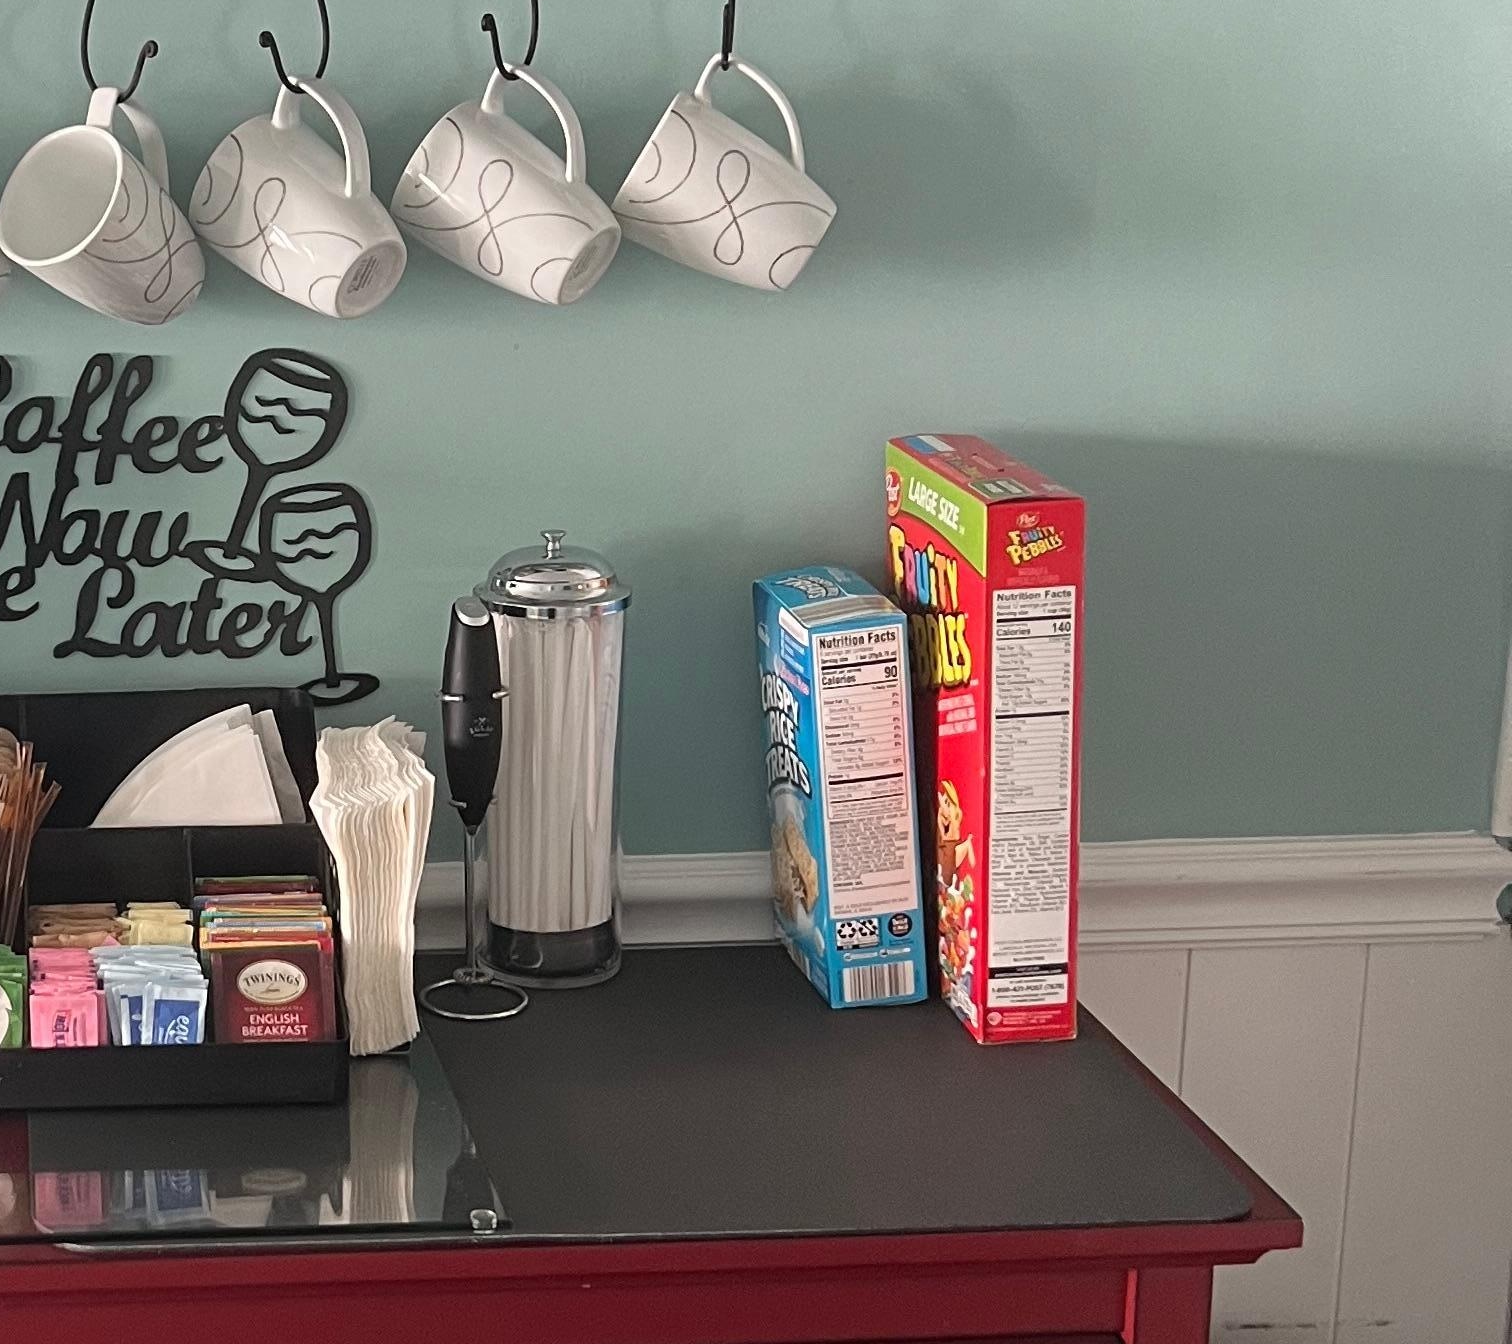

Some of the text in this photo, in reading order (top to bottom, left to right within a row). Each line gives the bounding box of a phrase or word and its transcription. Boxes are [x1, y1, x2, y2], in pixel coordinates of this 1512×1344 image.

[908, 476, 961, 529] LARGE SIZE
[1005, 534, 1065, 566] PEBBLES
[996, 589, 1072, 602] Nutrition Facts
[52, 563, 313, 659] Later
[996, 621, 1072, 637] Calories 140
[819, 630, 896, 650] Nutrition Facts
[821, 665, 898, 686] Calories 90
[761, 674, 799, 727] CRISPY
[769, 710, 796, 751] RICE
[765, 747, 811, 796] TREATS
[243, 971, 301, 987] TWININGS
[249, 1013, 300, 1025] ENGLISH
[241, 1024, 309, 1037] BREAKFAST
